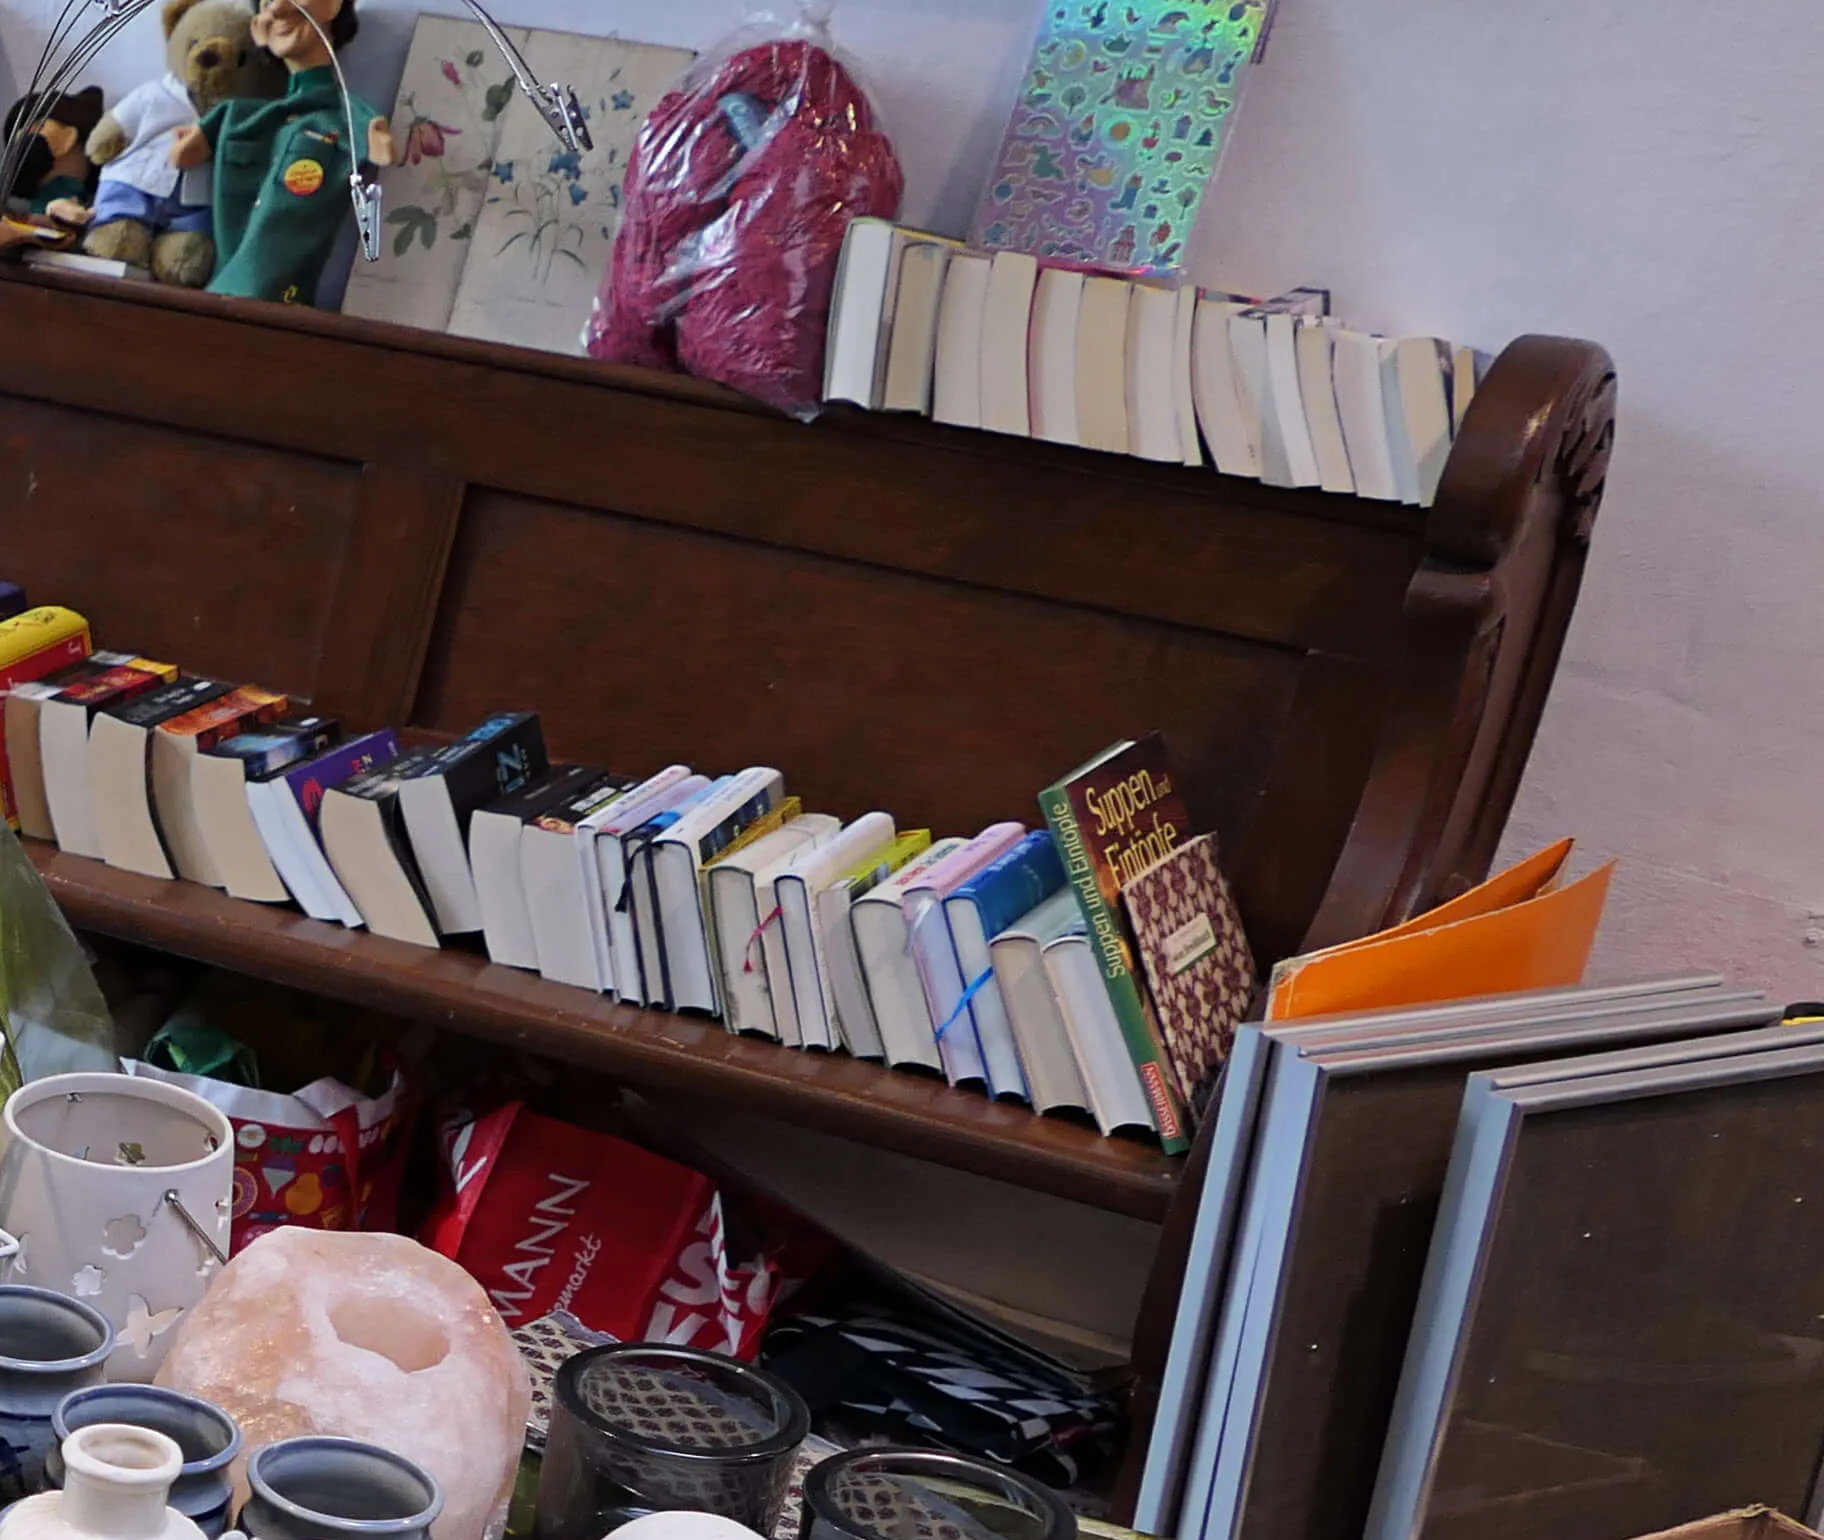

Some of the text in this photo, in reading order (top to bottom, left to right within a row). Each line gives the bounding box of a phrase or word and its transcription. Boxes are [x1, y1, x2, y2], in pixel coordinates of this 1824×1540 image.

[1086, 768, 1155, 839] Suppen
[1079, 874, 1100, 911] und
[1092, 914, 1126, 980] Suppen
